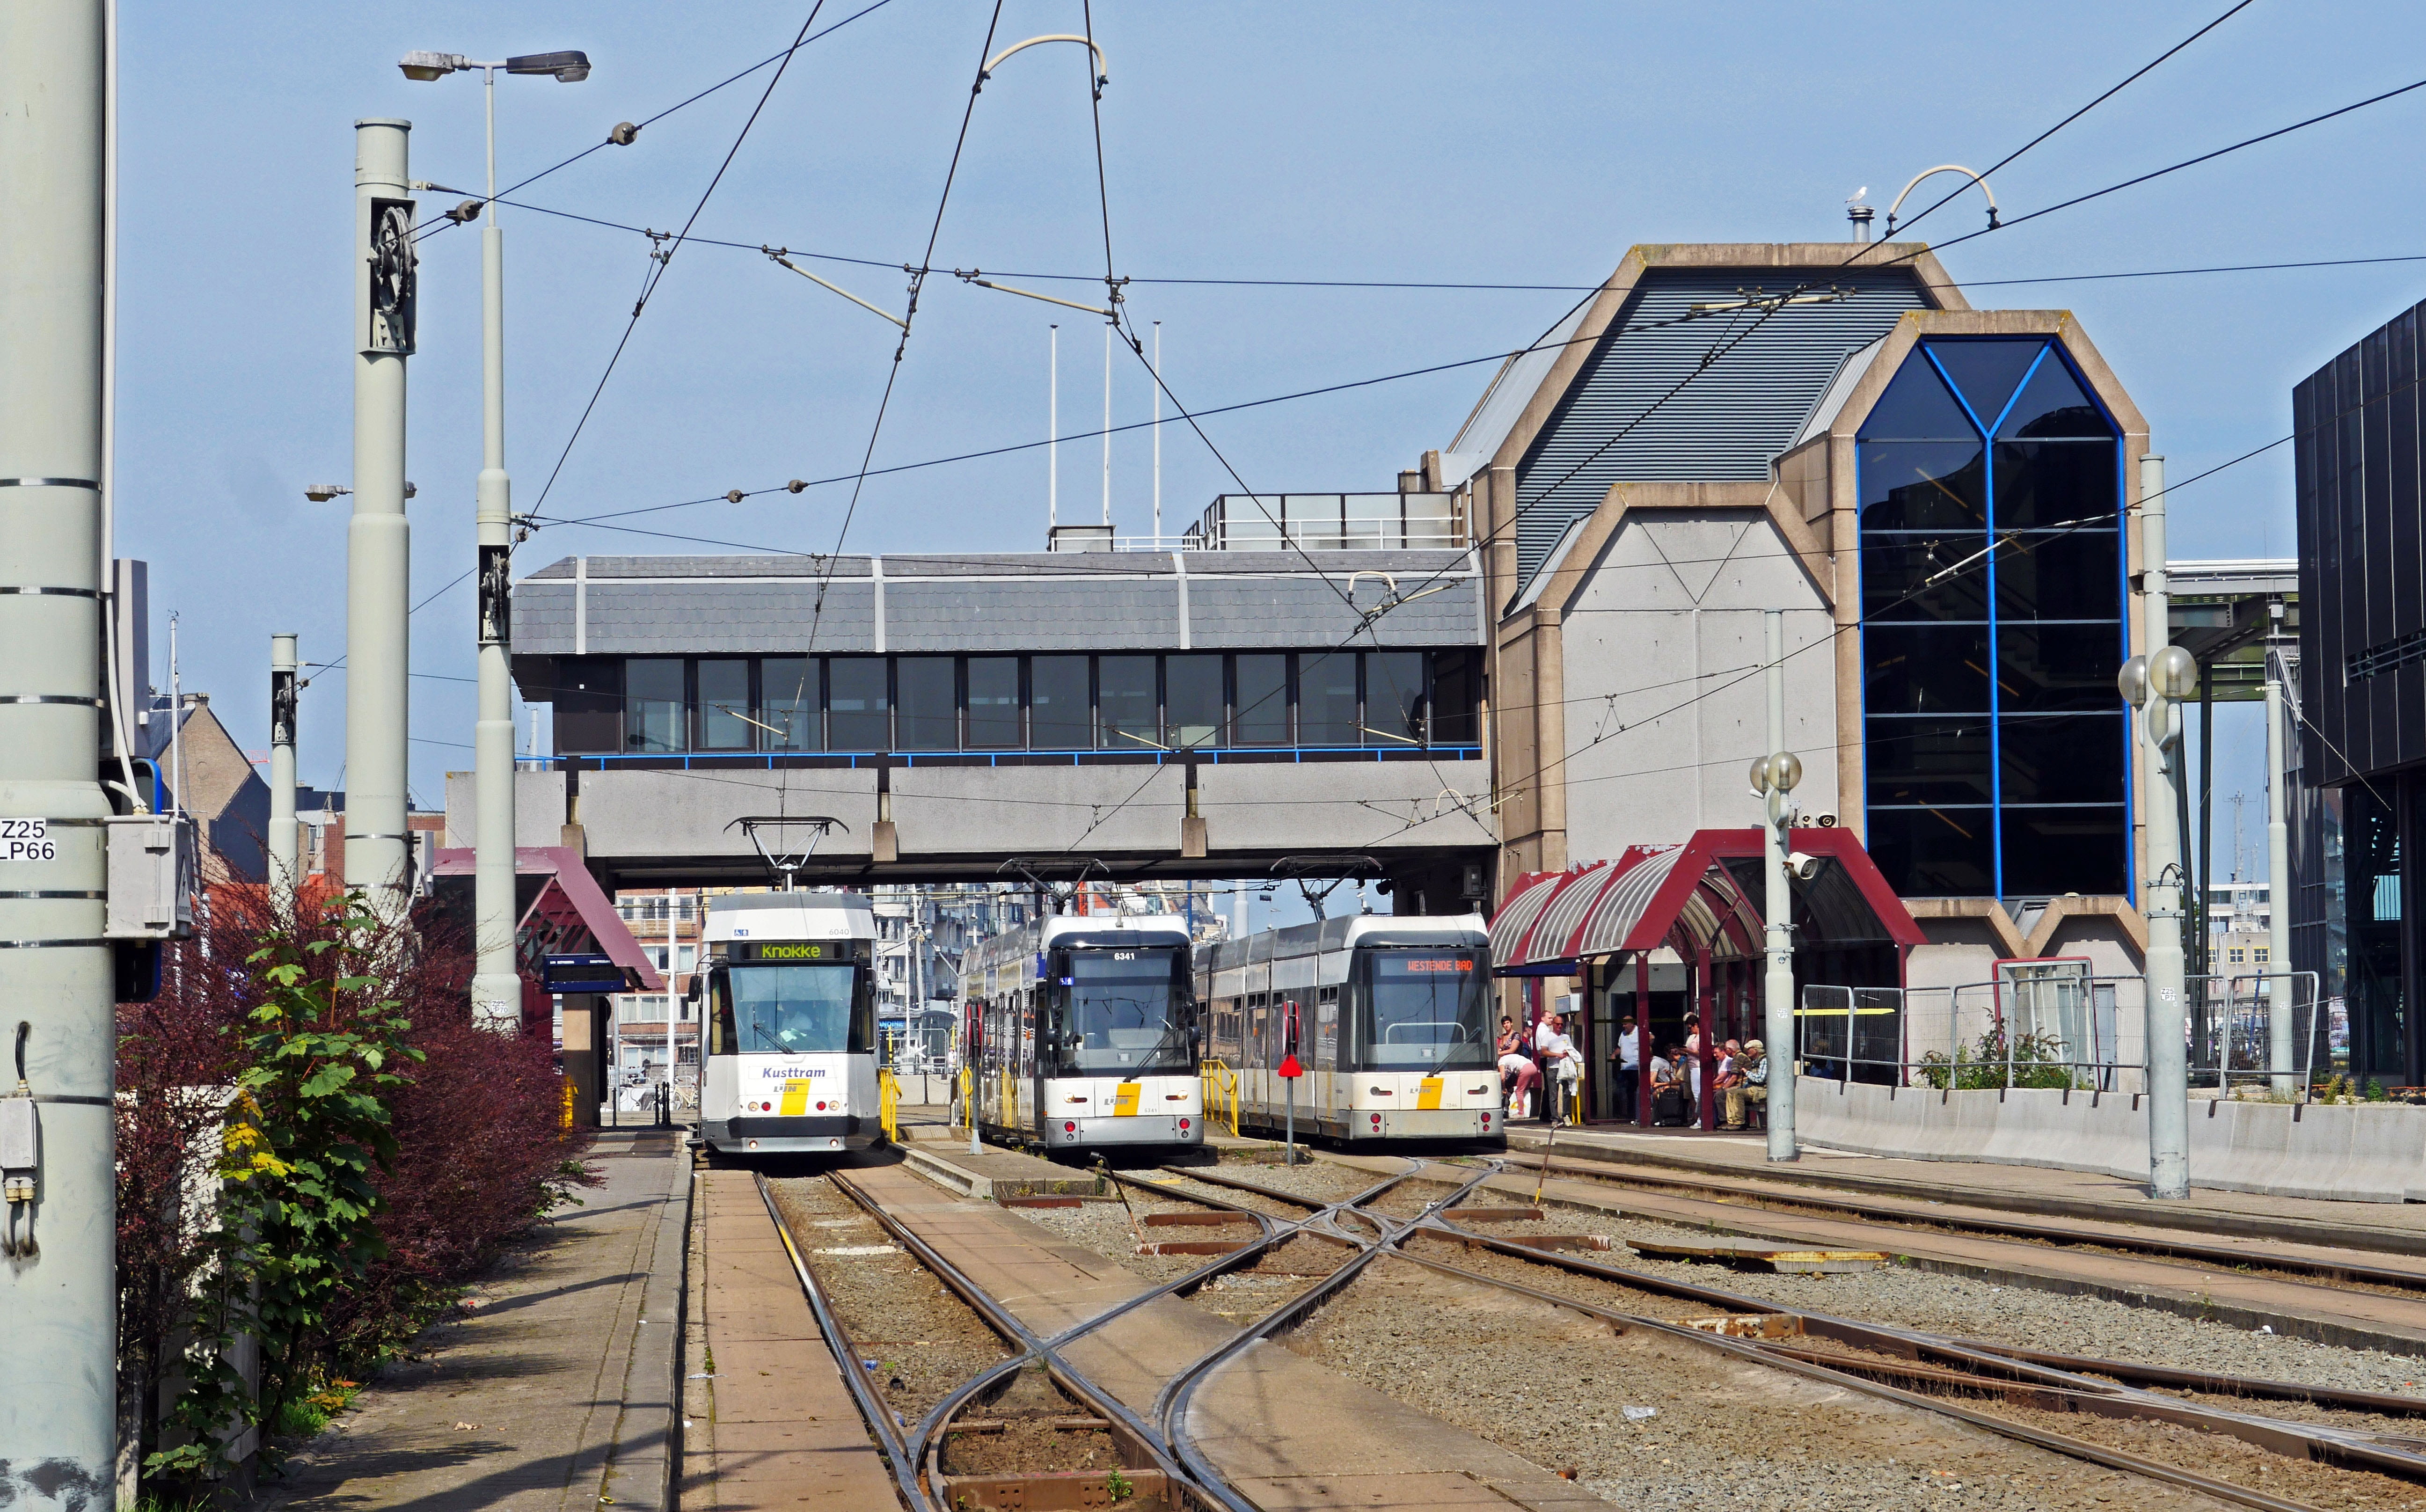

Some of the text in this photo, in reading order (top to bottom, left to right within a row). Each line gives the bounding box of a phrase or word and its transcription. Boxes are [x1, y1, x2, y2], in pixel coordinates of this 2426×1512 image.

[2, 821, 45, 838] Z25
[0, 842, 54, 860] P66
[762, 943, 821, 958] Knokke
[1408, 960, 1473, 971] WESTENDE BAD
[762, 1067, 826, 1078] Kusttram
